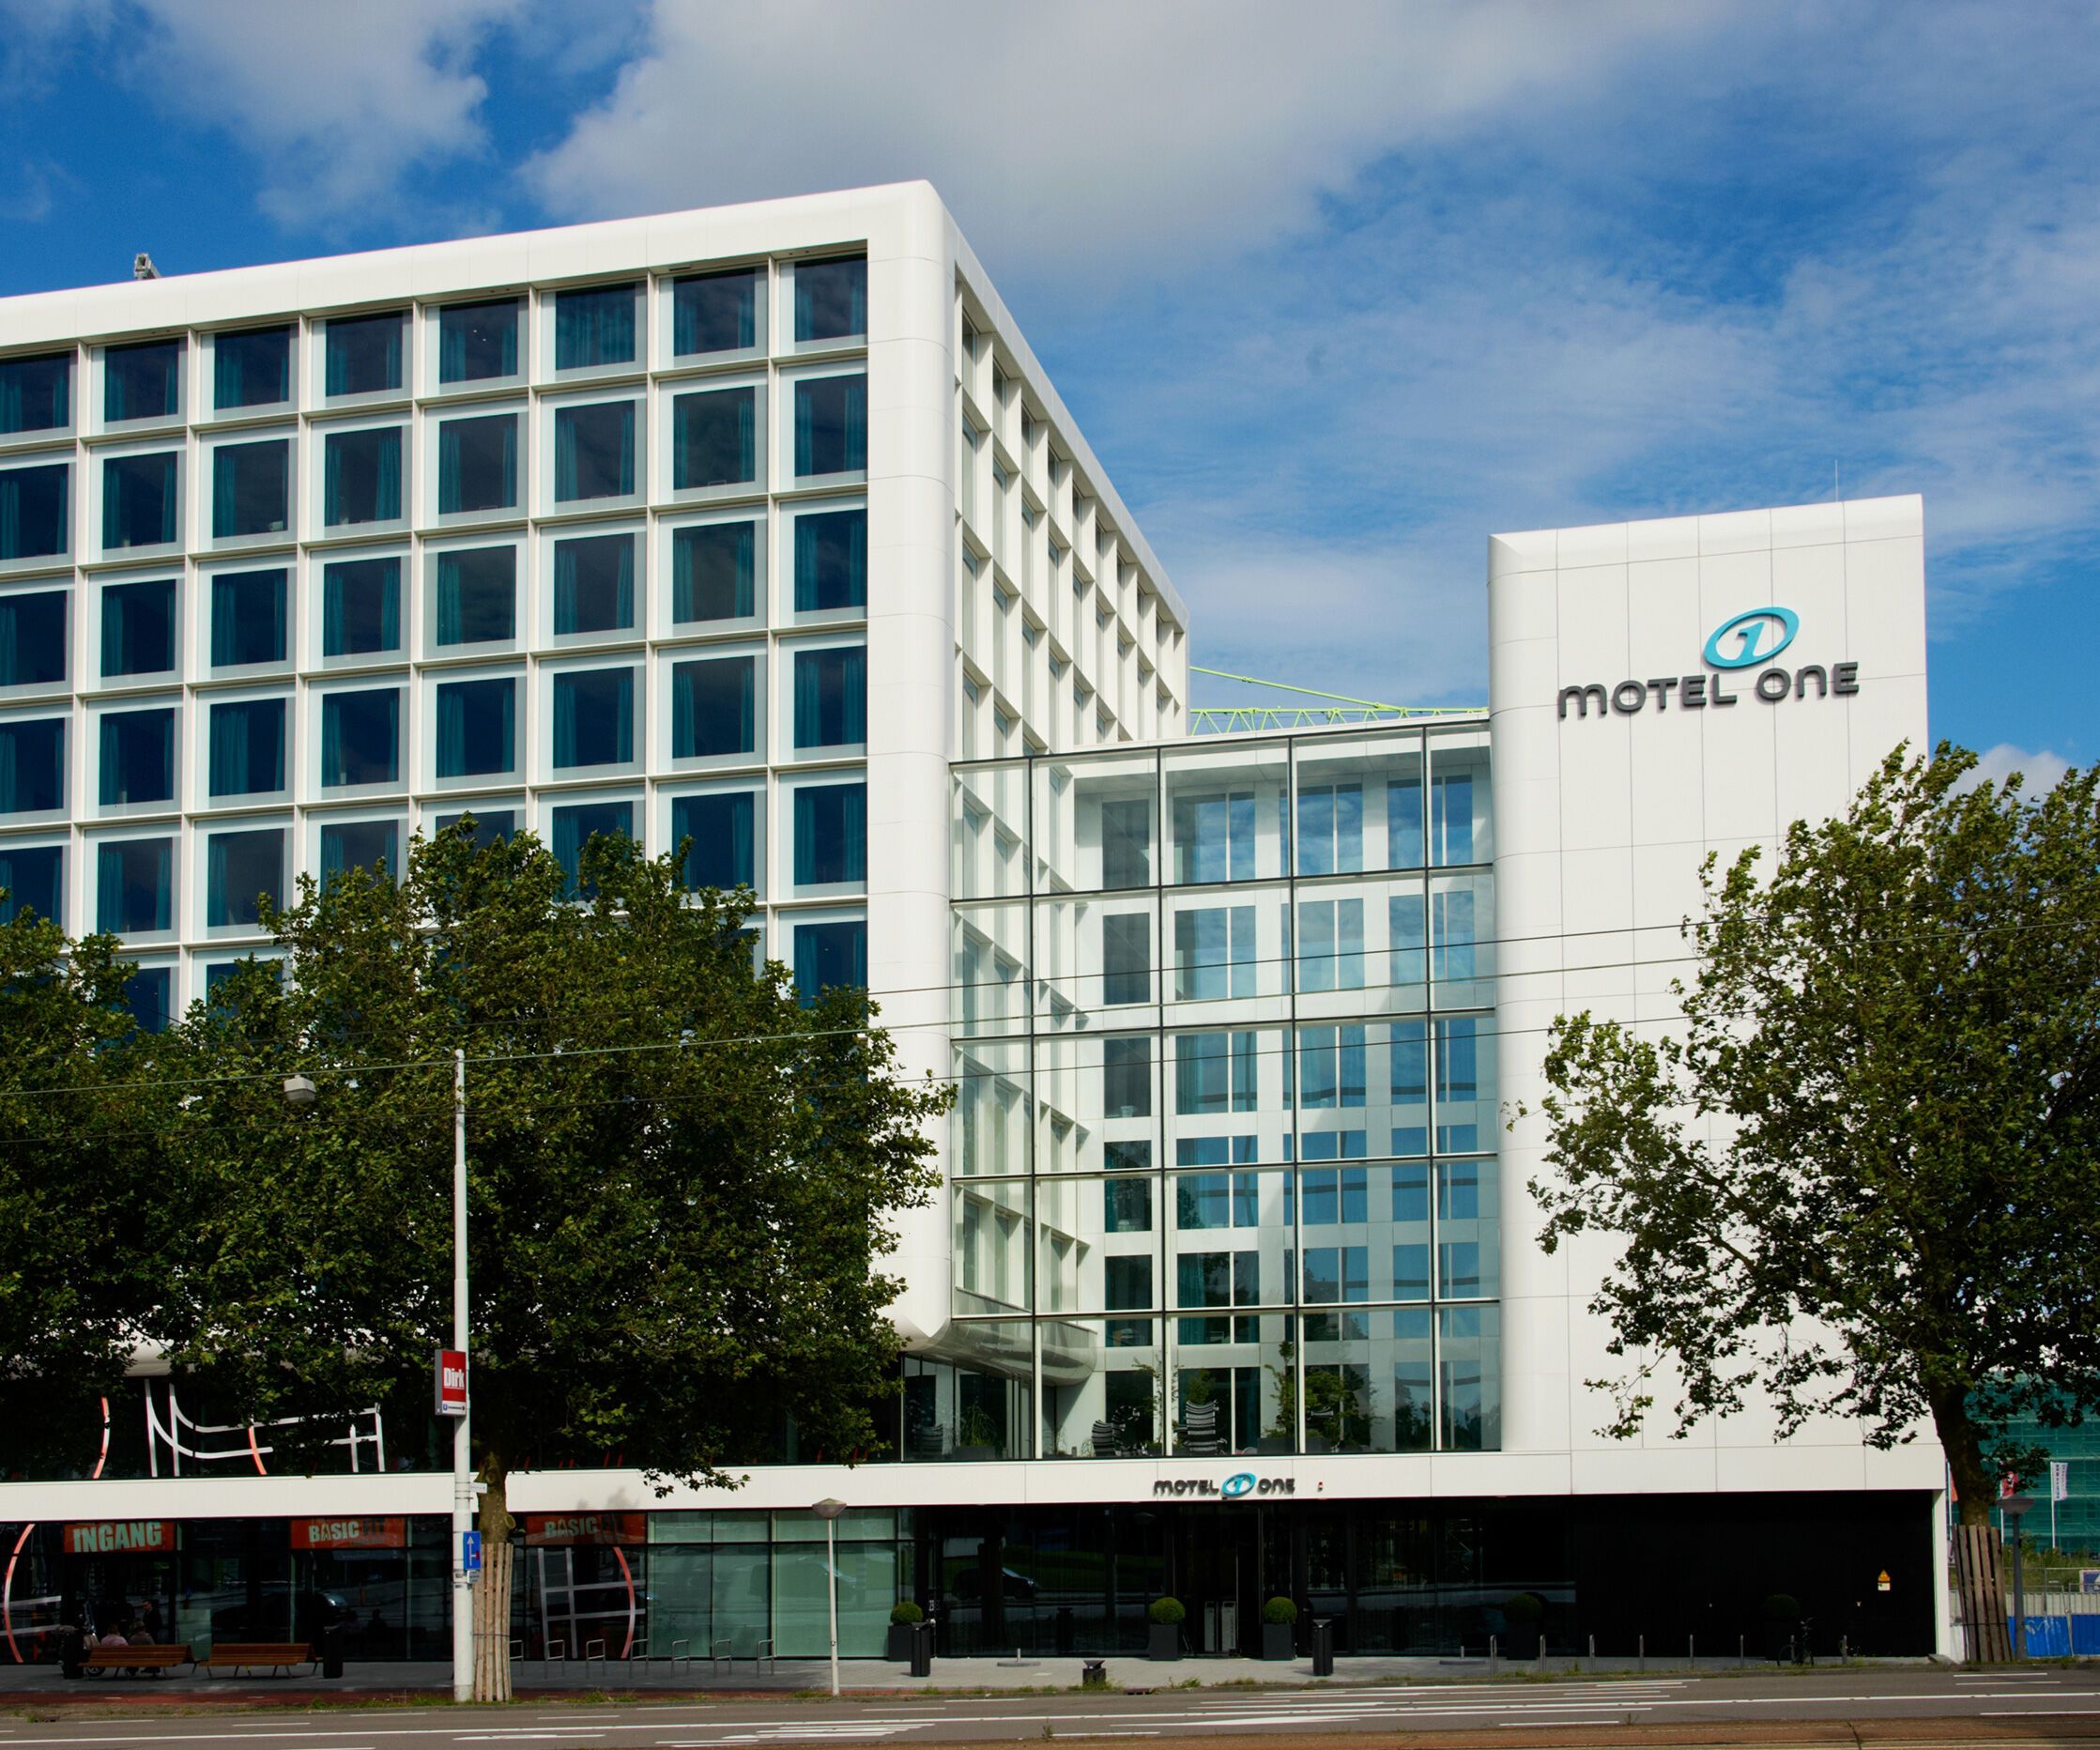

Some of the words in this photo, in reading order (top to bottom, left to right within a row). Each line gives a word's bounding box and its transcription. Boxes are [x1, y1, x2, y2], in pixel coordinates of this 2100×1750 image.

[443, 1367, 465, 1389] Dirk
[73, 1521, 161, 1553] INGANG
[308, 1521, 360, 1543] BASIC
[544, 1516, 597, 1539] BASIC
